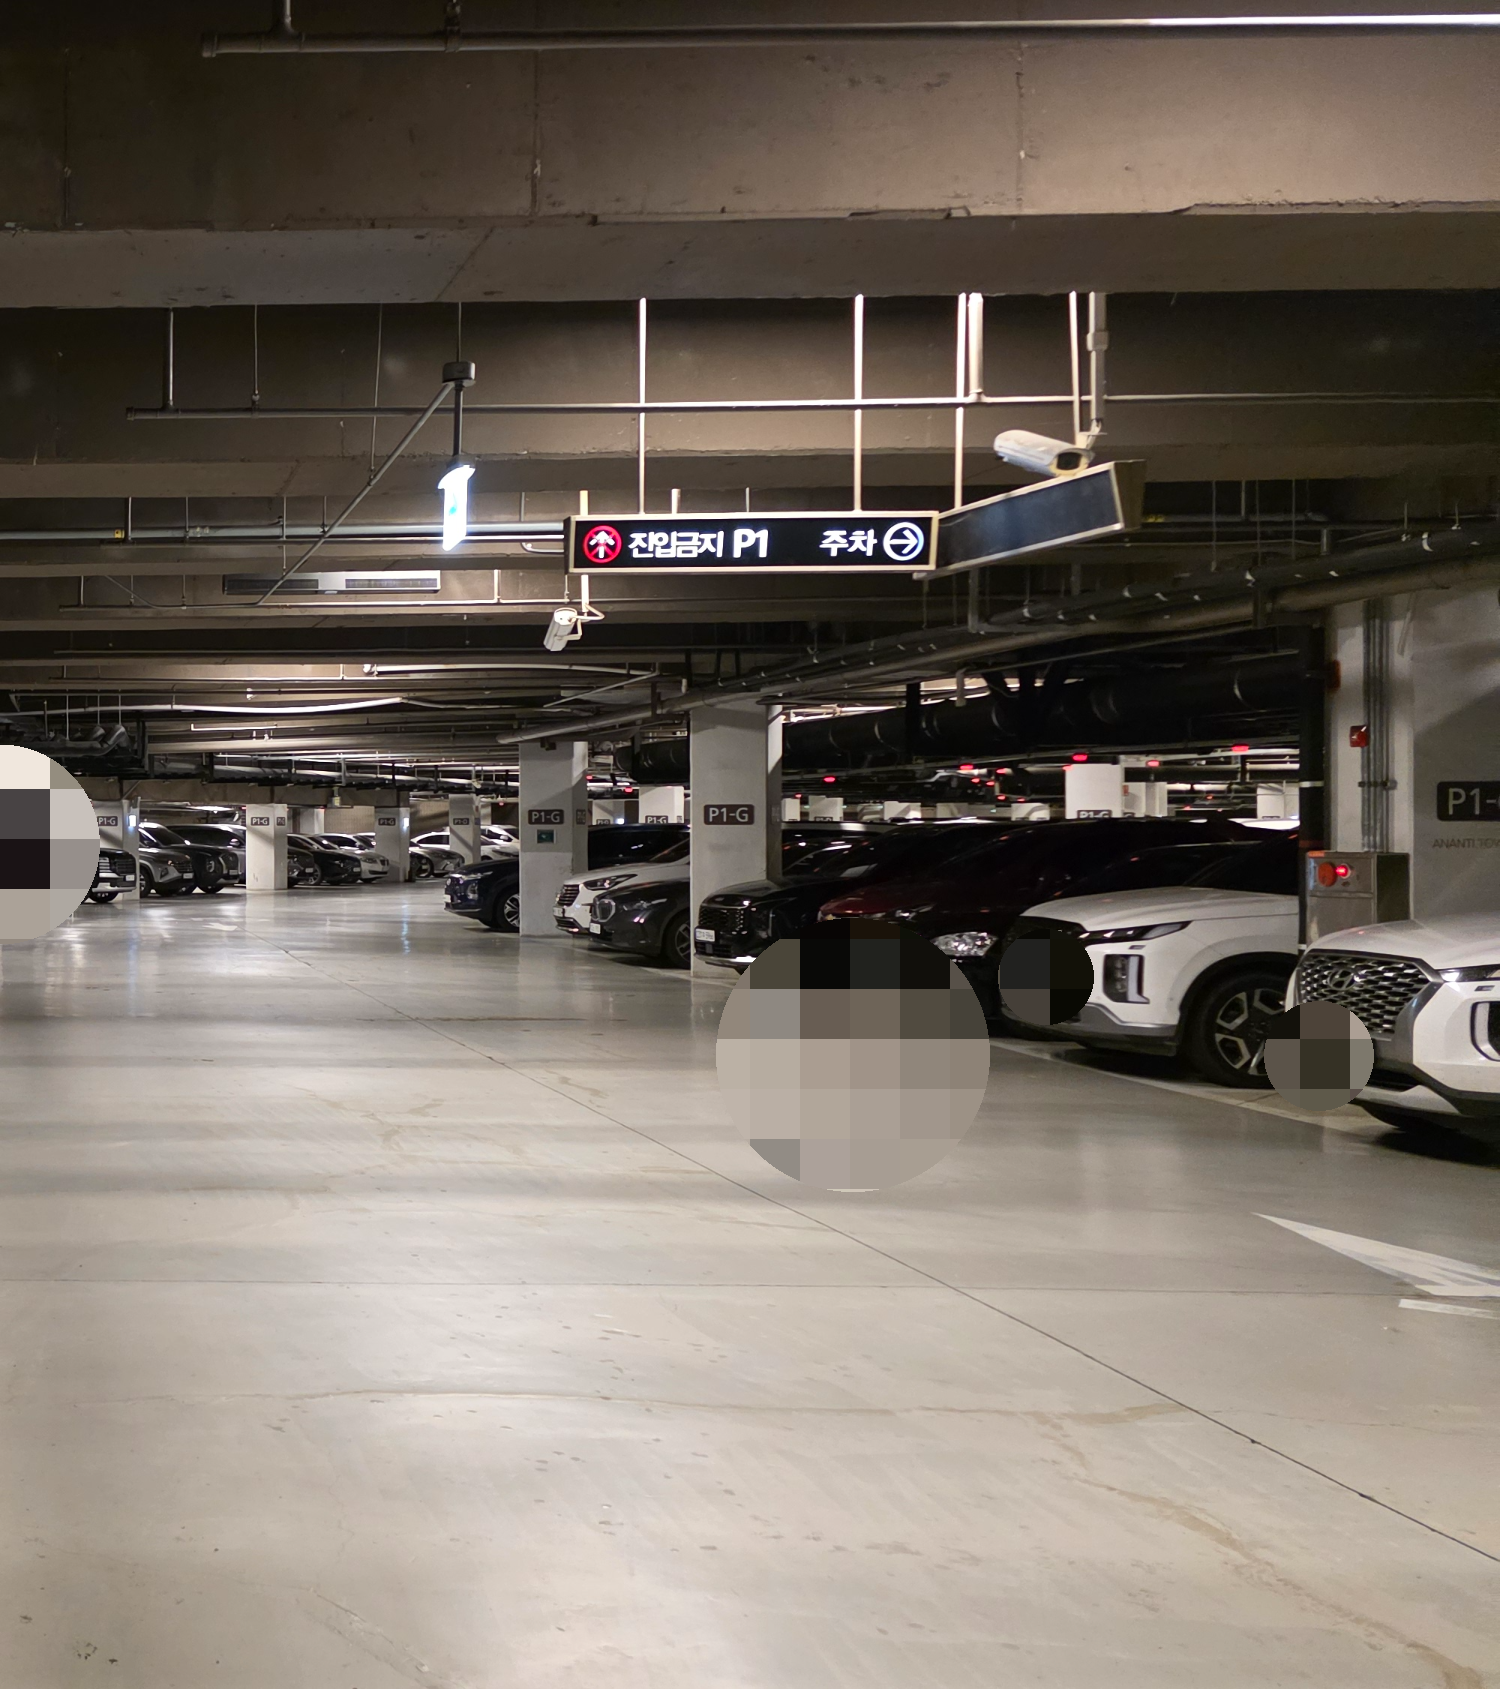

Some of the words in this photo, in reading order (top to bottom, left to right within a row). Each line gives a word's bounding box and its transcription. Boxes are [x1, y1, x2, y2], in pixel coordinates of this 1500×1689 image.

[628, 530, 725, 558] 진입금지
[733, 528, 769, 558] P1
[819, 530, 878, 557] 주차
[1448, 787, 1500, 815] P1-
[98, 817, 116, 825] P1-G
[531, 811, 560, 823] P1-G
[708, 807, 749, 822] P1-G
[1432, 838, 1476, 849] ANANTI
